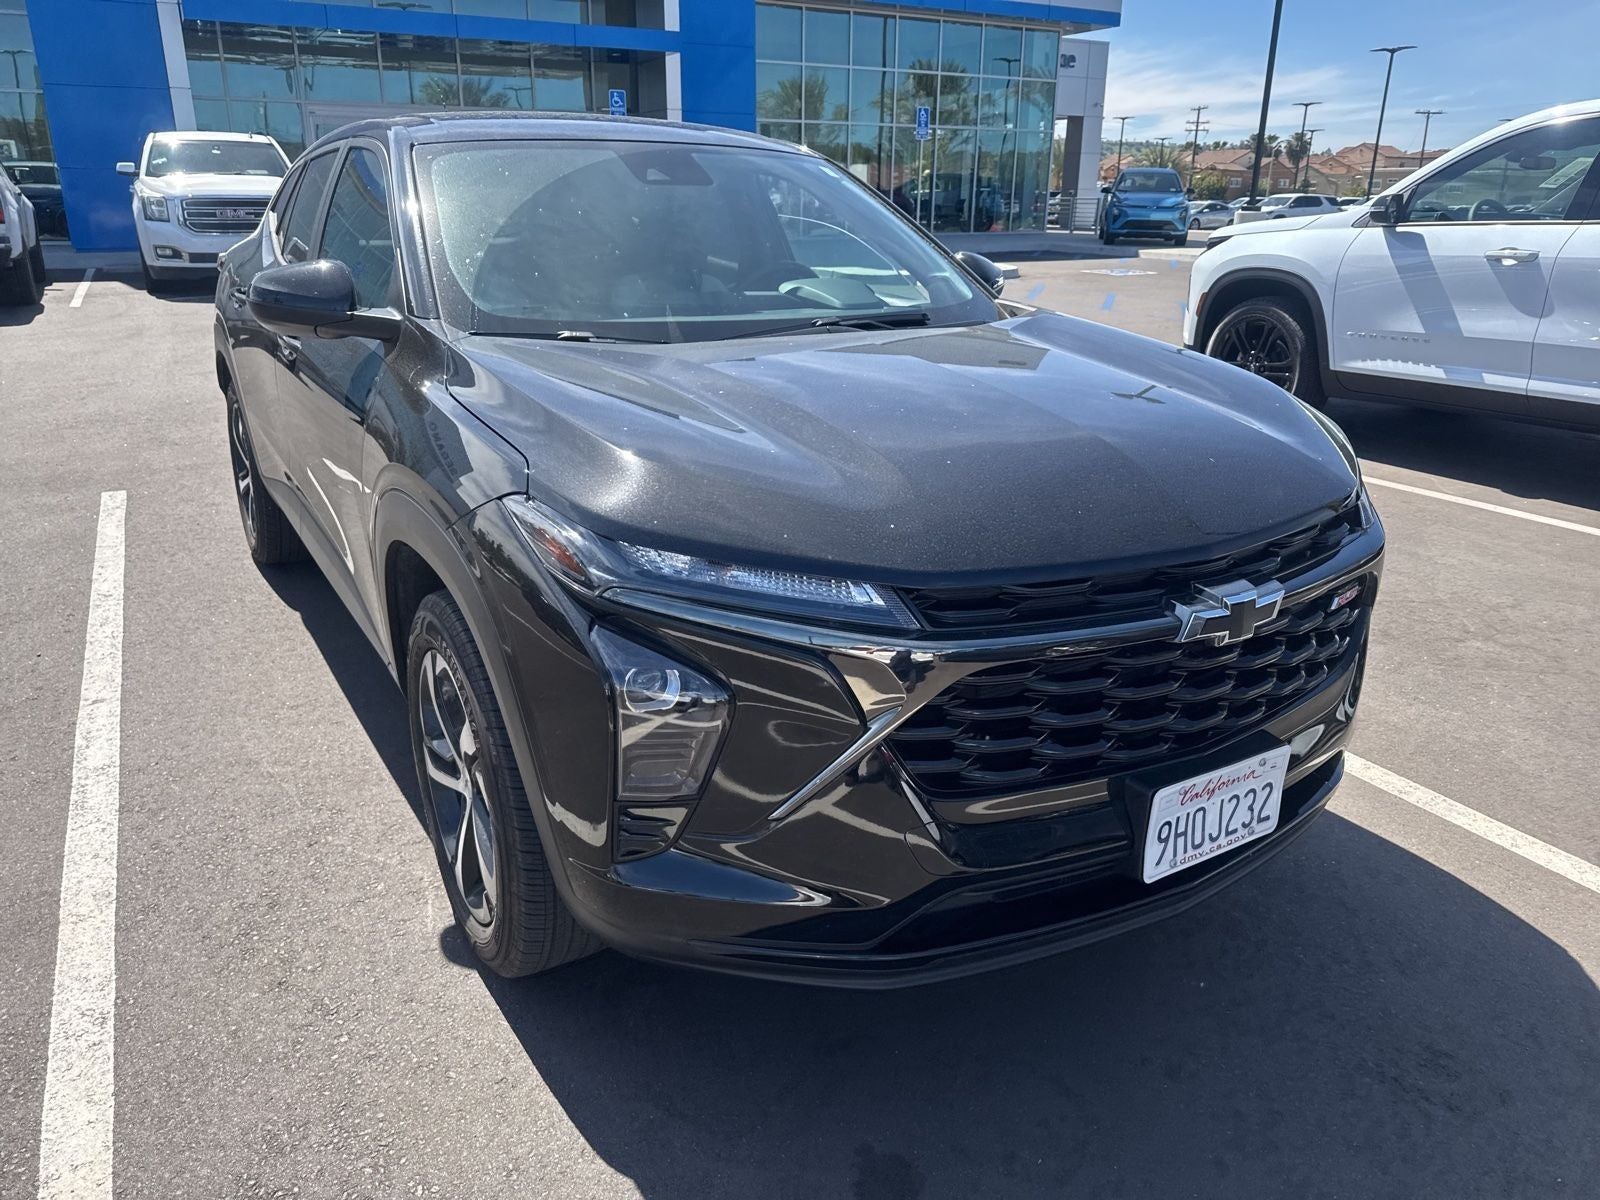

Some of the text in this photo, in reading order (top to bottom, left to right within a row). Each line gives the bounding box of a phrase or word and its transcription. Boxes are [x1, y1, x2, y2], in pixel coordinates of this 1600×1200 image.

[215, 208, 255, 219] GMC
[1178, 766, 1262, 806] California
[1179, 832, 1247, 865] dmv.ca.gov
